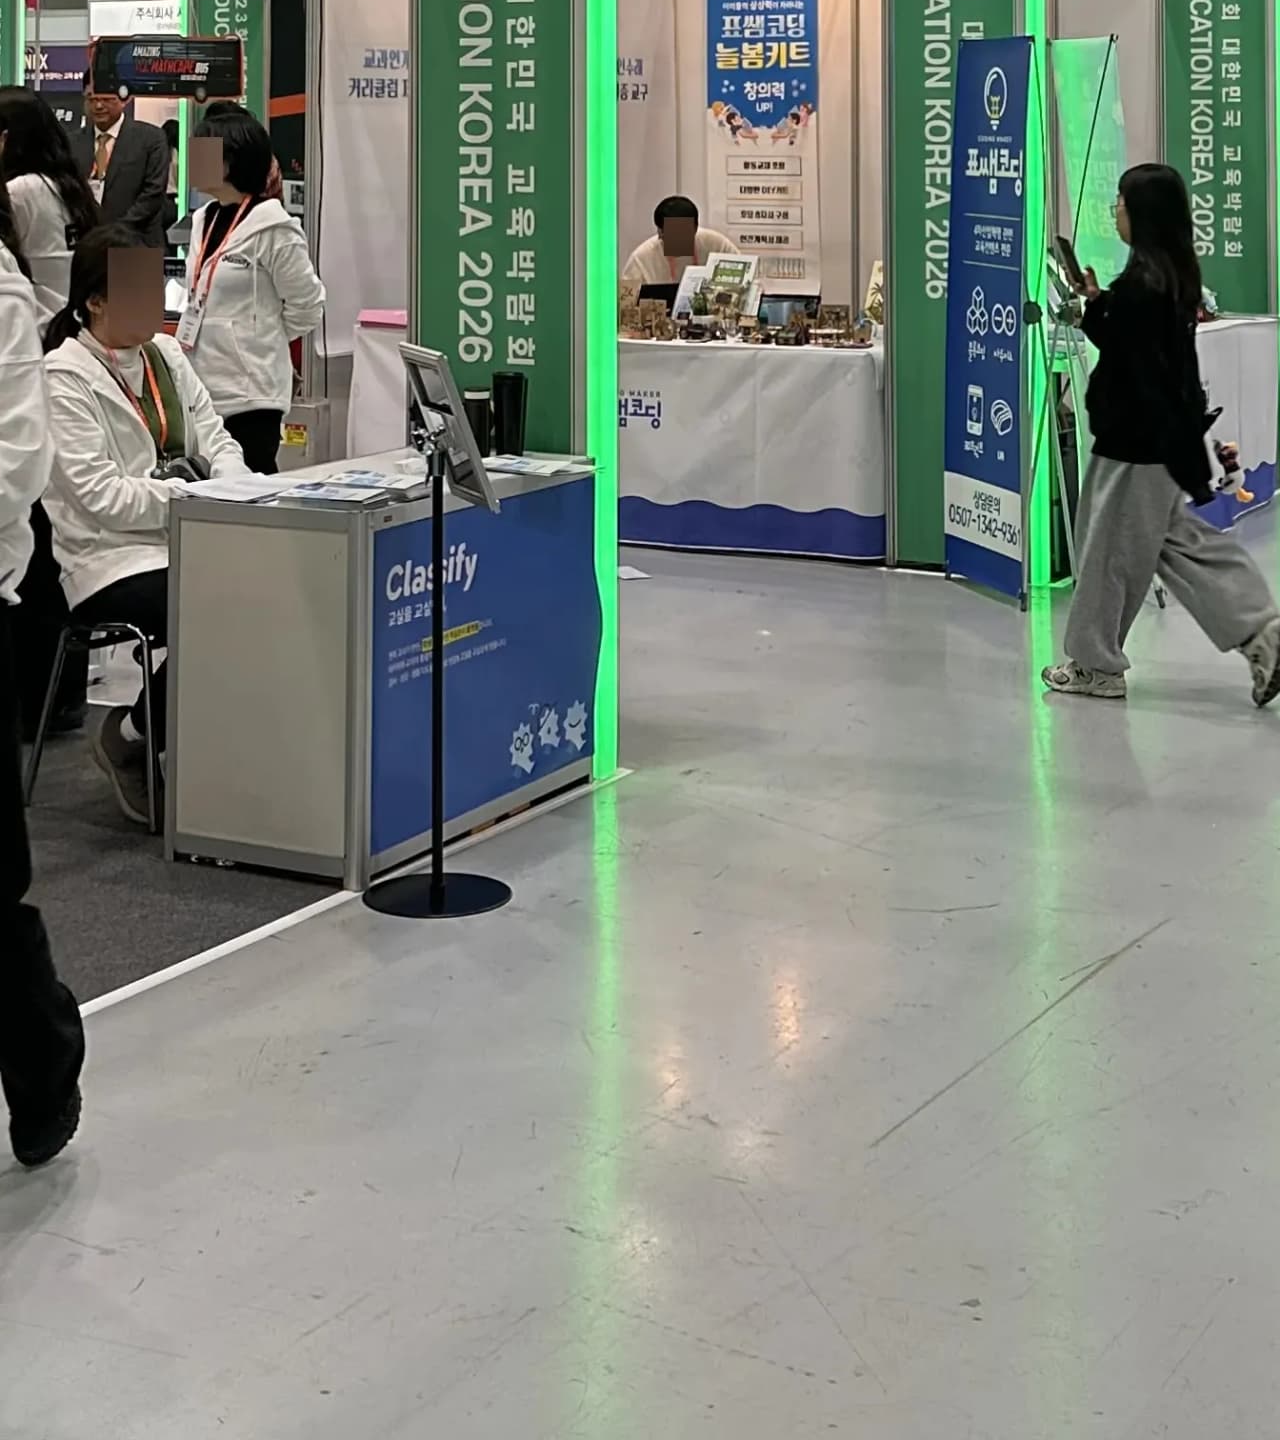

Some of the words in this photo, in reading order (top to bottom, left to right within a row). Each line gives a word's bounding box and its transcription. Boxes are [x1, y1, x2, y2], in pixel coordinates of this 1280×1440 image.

[715, 41, 811, 69] 늘봄키트
[721, 13, 806, 39] 표쌤코딩
[348, 78, 398, 98] 커리큘럼
[743, 81, 785, 101] 창의력
[1222, 39, 1241, 126] 대한민국
[459, 84, 492, 236] KOREA
[925, 100, 951, 208] KOREA
[965, 148, 1023, 197] 표쌤코딩
[1191, 100, 1213, 185] KOREA
[1192, 197, 1214, 256] 2026
[1223, 145, 1243, 257] 교육박람회
[507, 164, 535, 365] 교육박람회
[925, 220, 948, 299] 2026
[459, 252, 492, 362] 2026
[973, 491, 1001, 516] 상담문의
